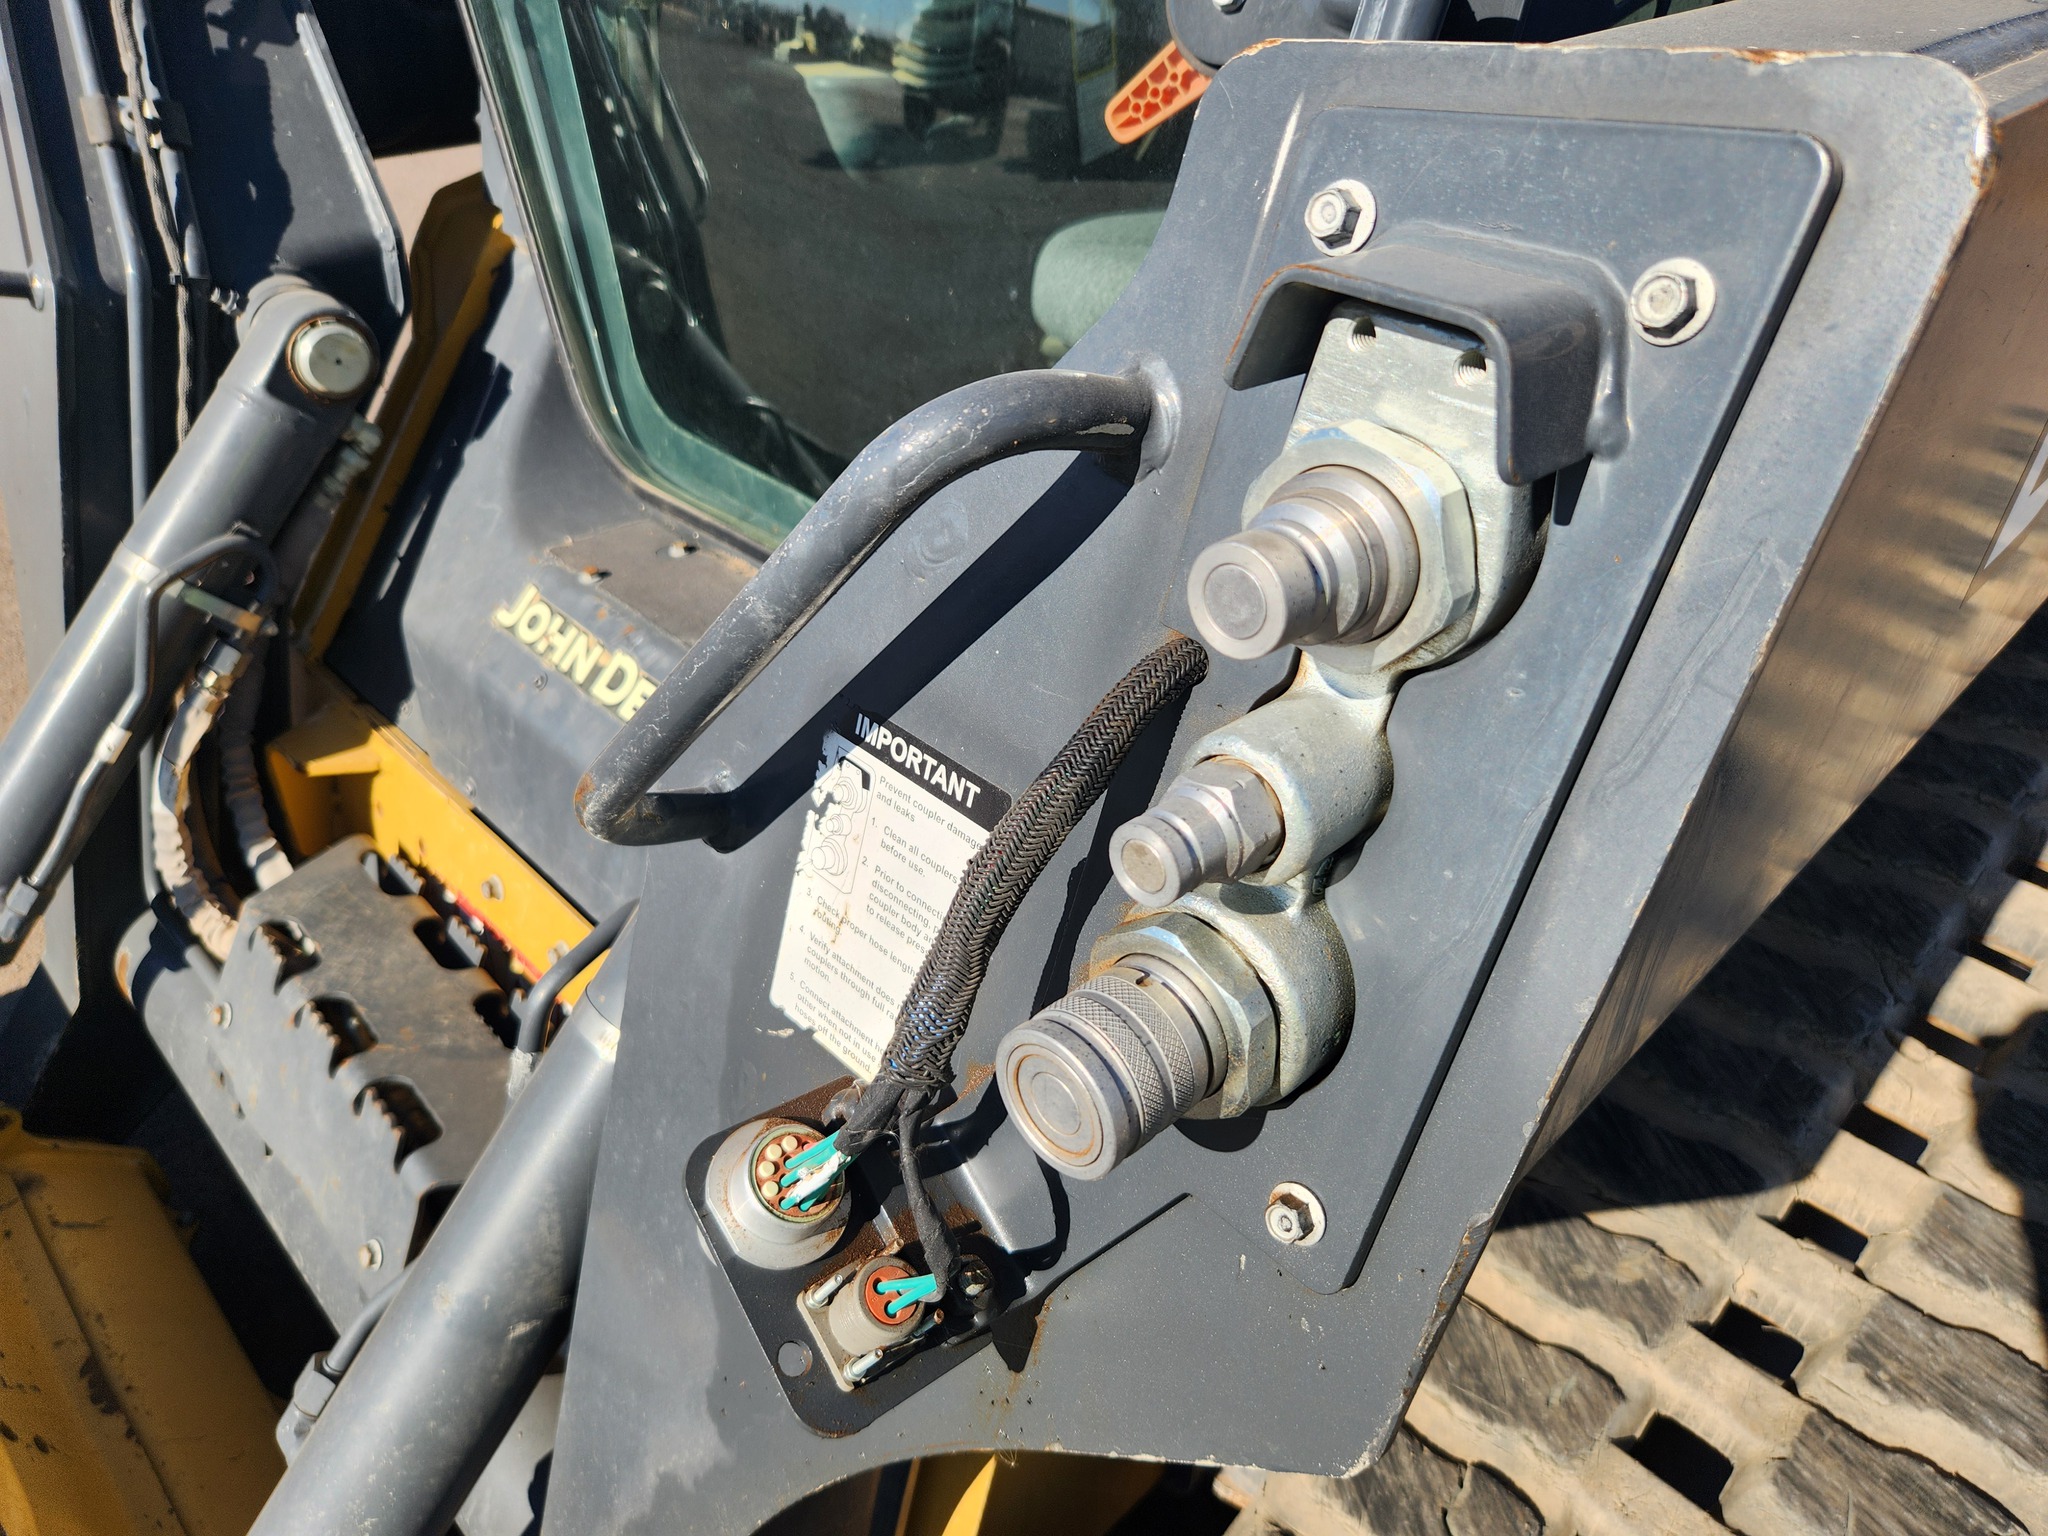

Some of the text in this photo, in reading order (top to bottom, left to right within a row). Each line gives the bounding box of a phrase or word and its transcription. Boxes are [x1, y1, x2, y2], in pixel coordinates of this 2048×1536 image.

[496, 582, 604, 684] JOHN
[855, 713, 981, 809] IMPORTANT
[876, 791, 915, 822] and leaks
[880, 775, 981, 850] Prevent coupler damage
[871, 817, 958, 884] 1. Clean all couplers
[880, 839, 926, 878] before use.
[861, 856, 945, 921] 2. Prior to connecti
[866, 904, 875, 916] to
[876, 913, 906, 939] release
[869, 892, 903, 922] coupler
[901, 915, 922, 937] body
[871, 879, 931, 929] disconnecting,
[799, 925, 895, 1006] 4. Verify attachment does
[807, 887, 916, 977] 3. Check proper hose length
[804, 957, 831, 983] motion.
[807, 945, 839, 975] couplers
[840, 971, 871, 1001] through
[872, 996, 885, 1014] full
[790, 971, 796, 983] 5.
[800, 980, 831, 1011] Connect
[831, 1007, 874, 1046] attachment
[794, 1003, 816, 1026] hoses
[817, 1024, 829, 1036] off
[830, 1033, 841, 1047] the
[842, 1046, 872, 1074] ground.
[797, 993, 876, 1062] other when not in use
